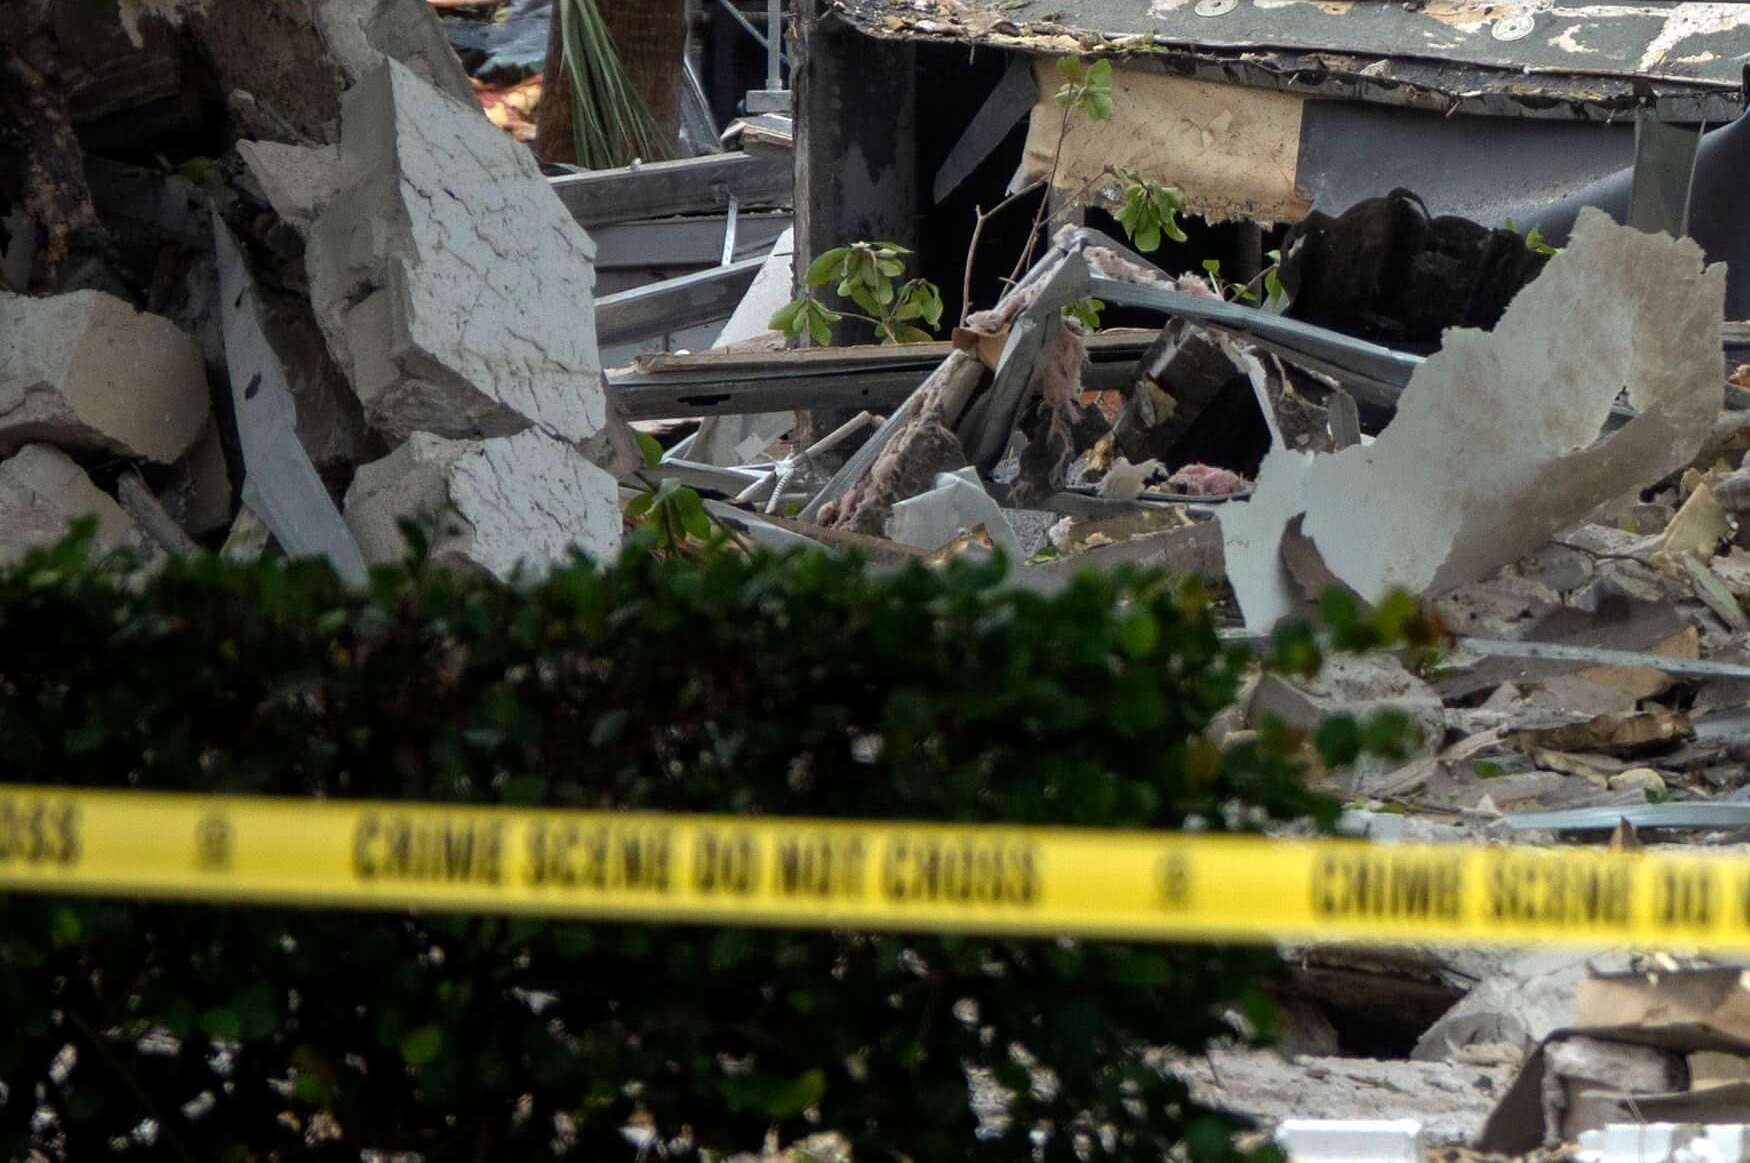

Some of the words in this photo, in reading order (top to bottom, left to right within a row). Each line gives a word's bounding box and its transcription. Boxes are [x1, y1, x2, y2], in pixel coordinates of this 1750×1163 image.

[355, 810, 503, 886] CRIME
[522, 817, 675, 892] SCENE
[692, 828, 758, 896] DO
[774, 831, 865, 898] NOT
[883, 836, 1040, 904] CROSS
[1311, 848, 1463, 922] CRIME
[1484, 854, 1634, 926] SCENE
[1656, 860, 1722, 928] DO
